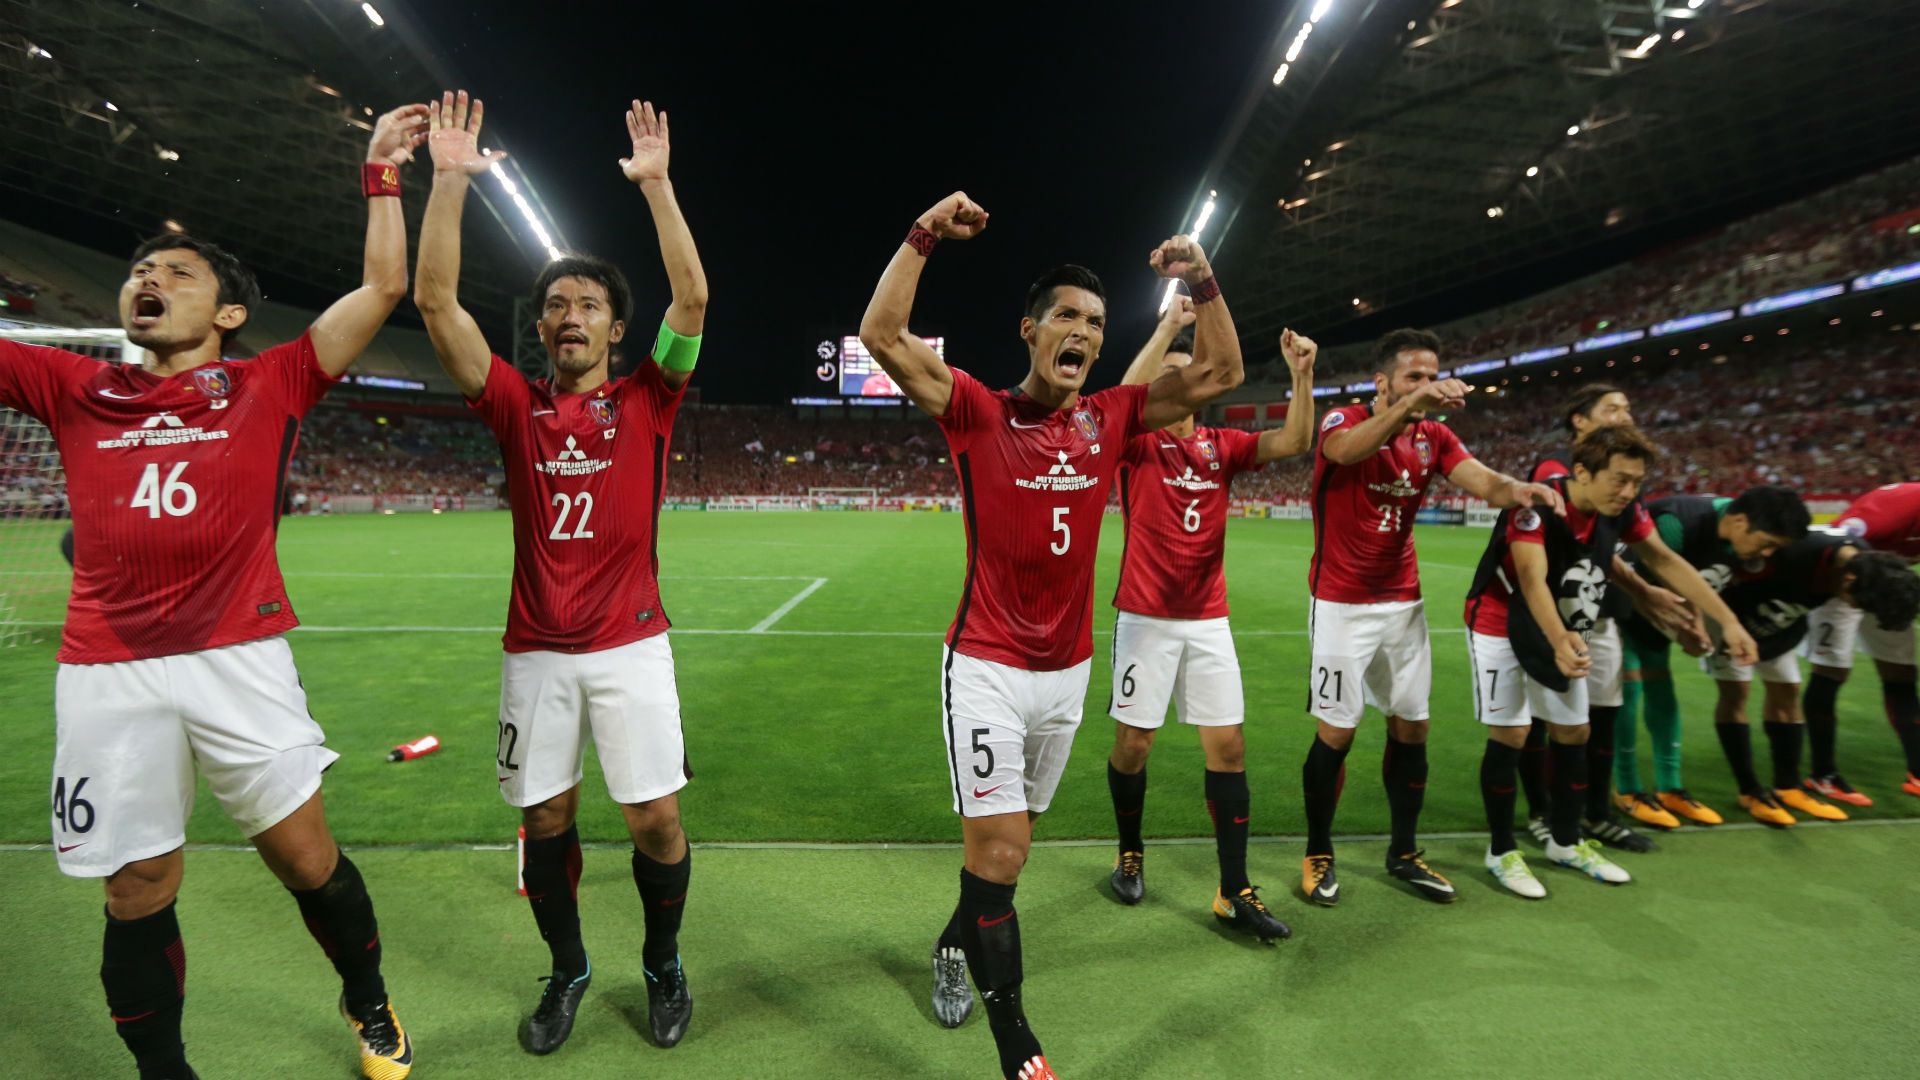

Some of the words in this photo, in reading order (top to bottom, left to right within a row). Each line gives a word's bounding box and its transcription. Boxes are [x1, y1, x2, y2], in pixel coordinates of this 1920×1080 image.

[382, 167, 397, 186] 46
[97, 438, 141, 449] HEAVY
[145, 430, 229, 446] INDUSTRIES
[122, 427, 203, 439] MITSUBISHI
[546, 458, 599, 469] MITSUBISHI
[1035, 474, 1087, 484] MITSUBISHI
[130, 461, 198, 519] 46
[1015, 478, 1049, 491] HEAVY
[549, 492, 594, 540] 22
[1050, 507, 1071, 556] 5
[1183, 499, 1201, 533] 6
[1818, 621, 1834, 647] 2
[1121, 663, 1137, 698] 6
[1318, 666, 1343, 702] 21
[1486, 669, 1499, 701] 7
[497, 719, 519, 771] 22
[971, 728, 995, 779] 5
[53, 776, 96, 834] 46
